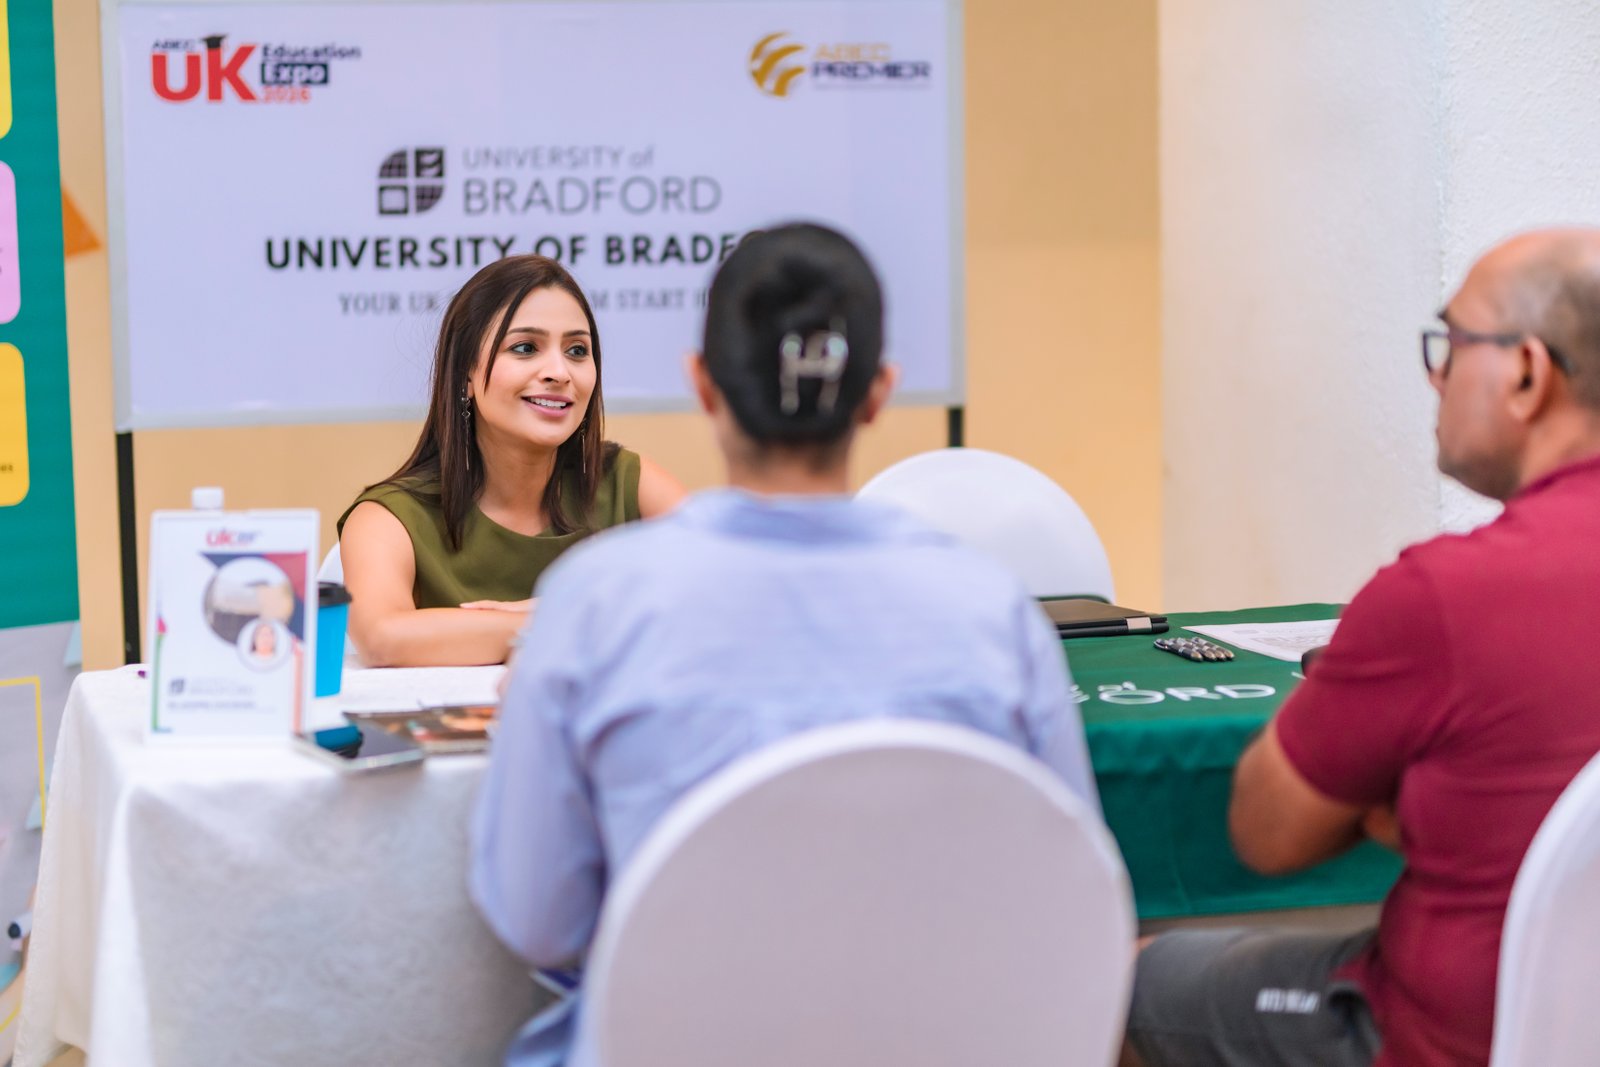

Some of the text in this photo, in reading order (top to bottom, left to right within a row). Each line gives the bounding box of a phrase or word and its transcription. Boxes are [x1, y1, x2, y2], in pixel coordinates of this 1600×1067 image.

[262, 43, 361, 59] Education
[152, 45, 257, 102] UK
[264, 64, 327, 84] Expo
[462, 144, 655, 168] UNIVERSITY of
[463, 176, 722, 215] BRADFORD
[265, 234, 737, 269] UNIVERSITY OF BRADF
[339, 291, 401, 315] YOUR
[616, 288, 685, 310] START
